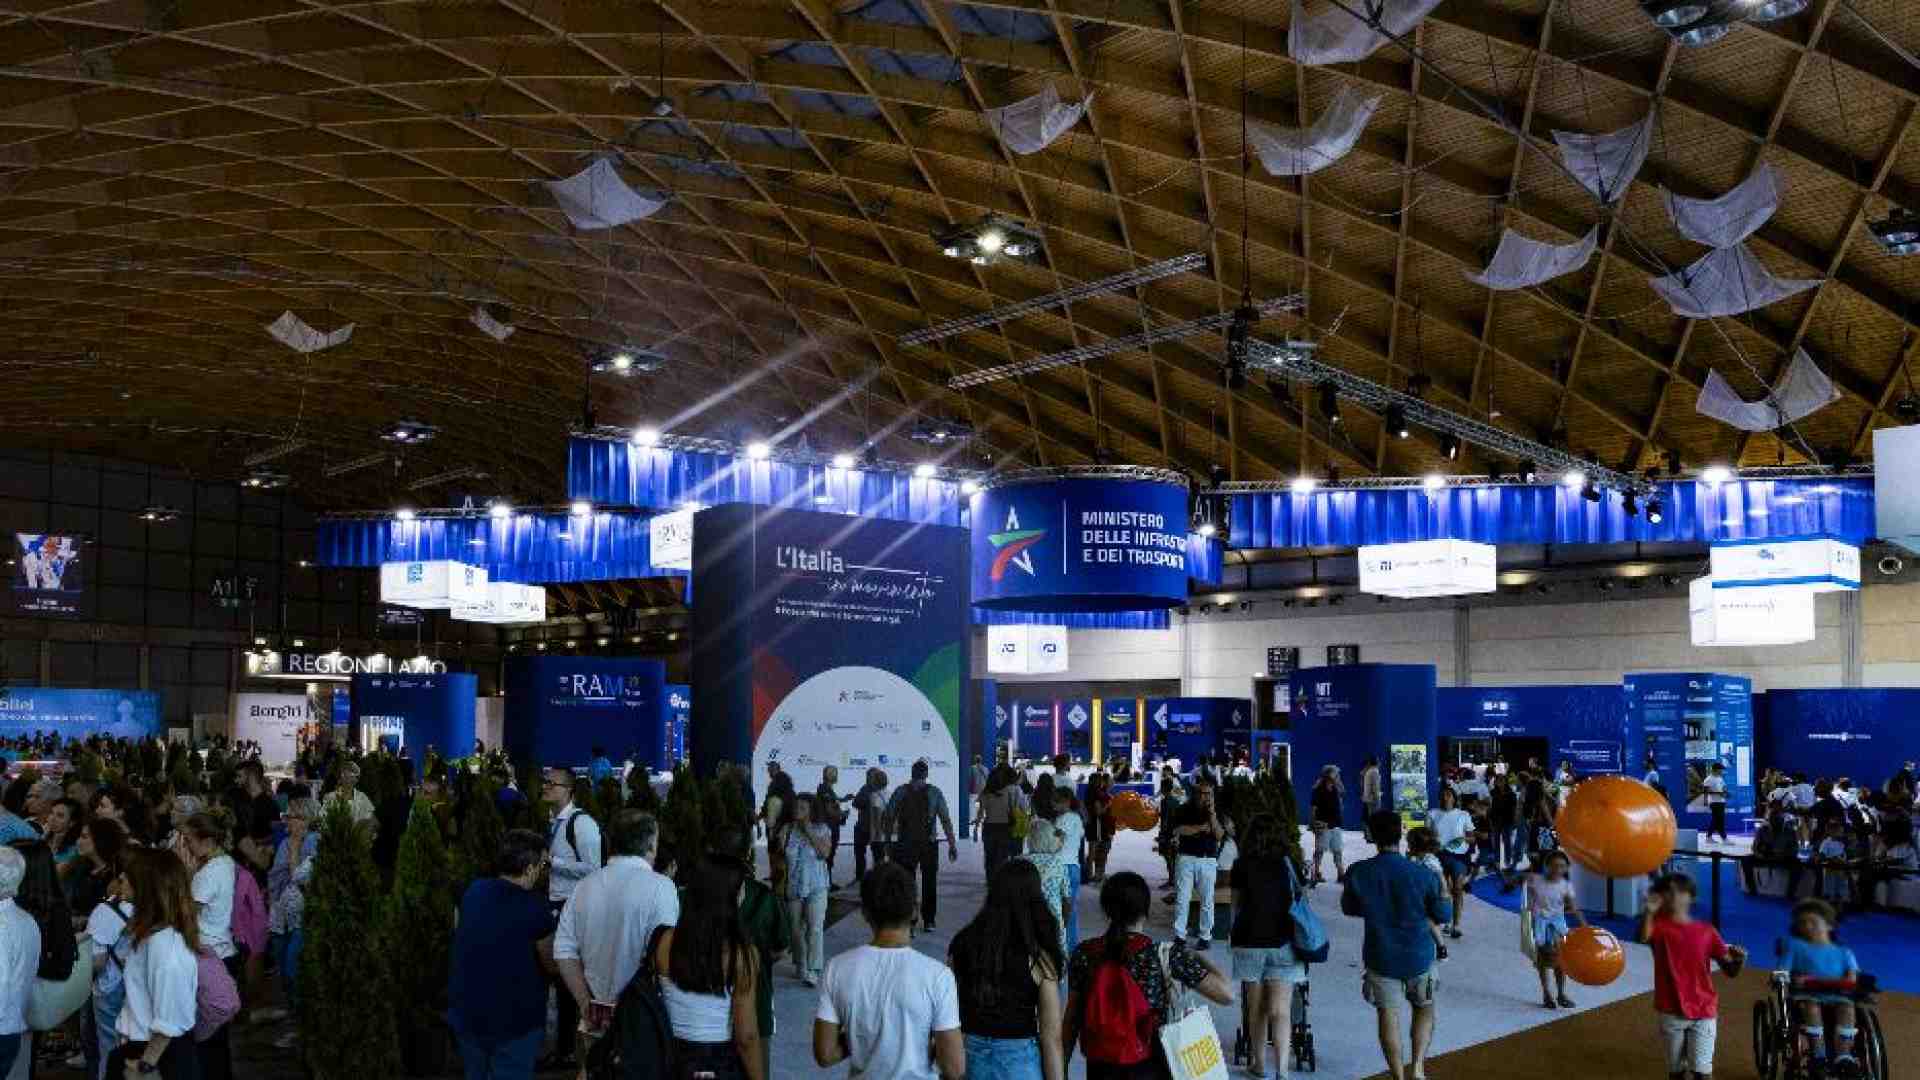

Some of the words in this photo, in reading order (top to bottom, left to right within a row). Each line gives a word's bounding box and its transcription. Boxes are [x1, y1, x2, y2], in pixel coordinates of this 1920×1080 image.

[1082, 511, 1164, 529] MINISTERO
[1083, 530, 1130, 544] DELLE
[776, 546, 844, 573] L'Italia
[1083, 549, 1093, 562] E
[1098, 549, 1123, 562] DEI
[573, 674, 624, 697] RAM
[250, 705, 302, 720] Borghi
